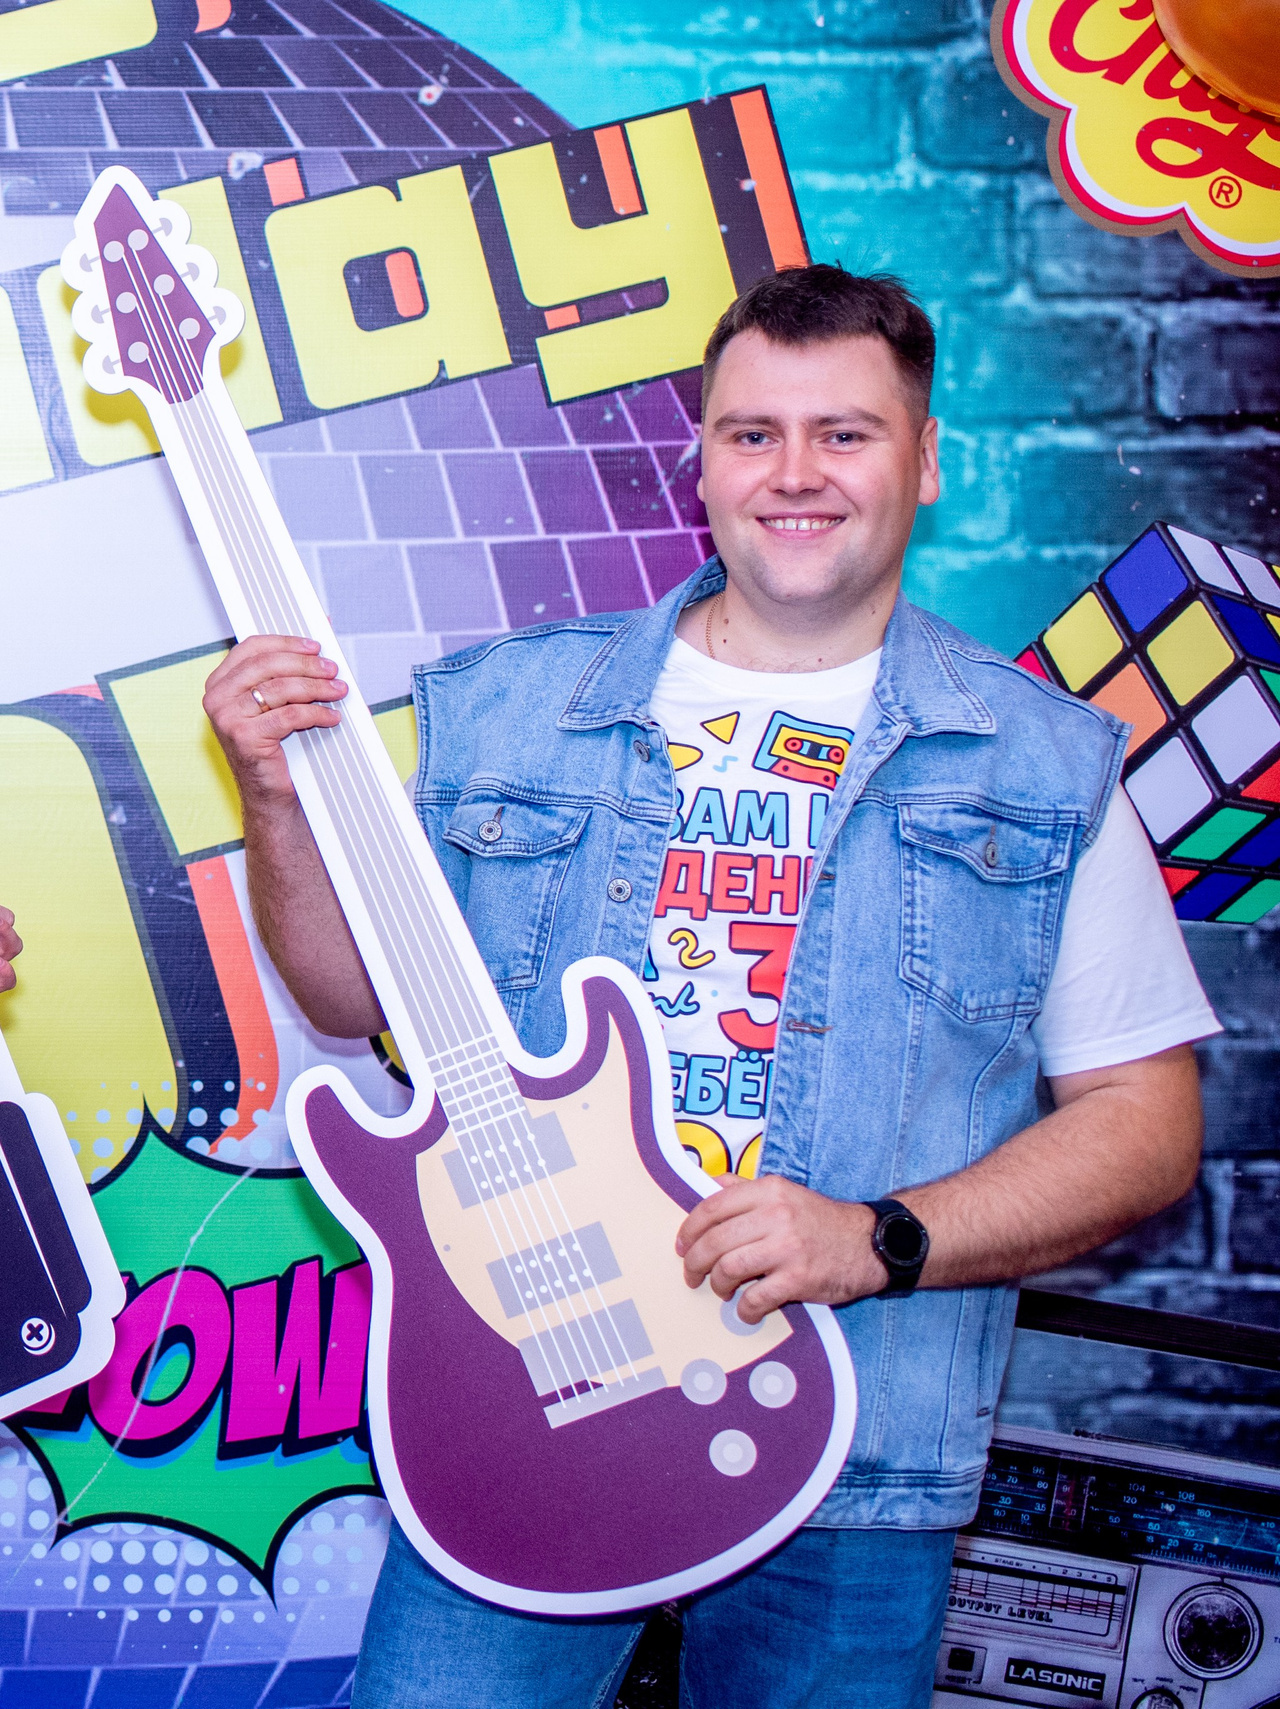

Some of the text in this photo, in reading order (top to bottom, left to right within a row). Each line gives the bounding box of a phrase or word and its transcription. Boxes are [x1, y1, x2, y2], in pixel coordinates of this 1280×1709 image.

[654, 847, 813, 922] ДЕН
[20, 1256, 373, 1442] OW
[948, 1595, 1053, 1623] OUTPUT LEVEL
